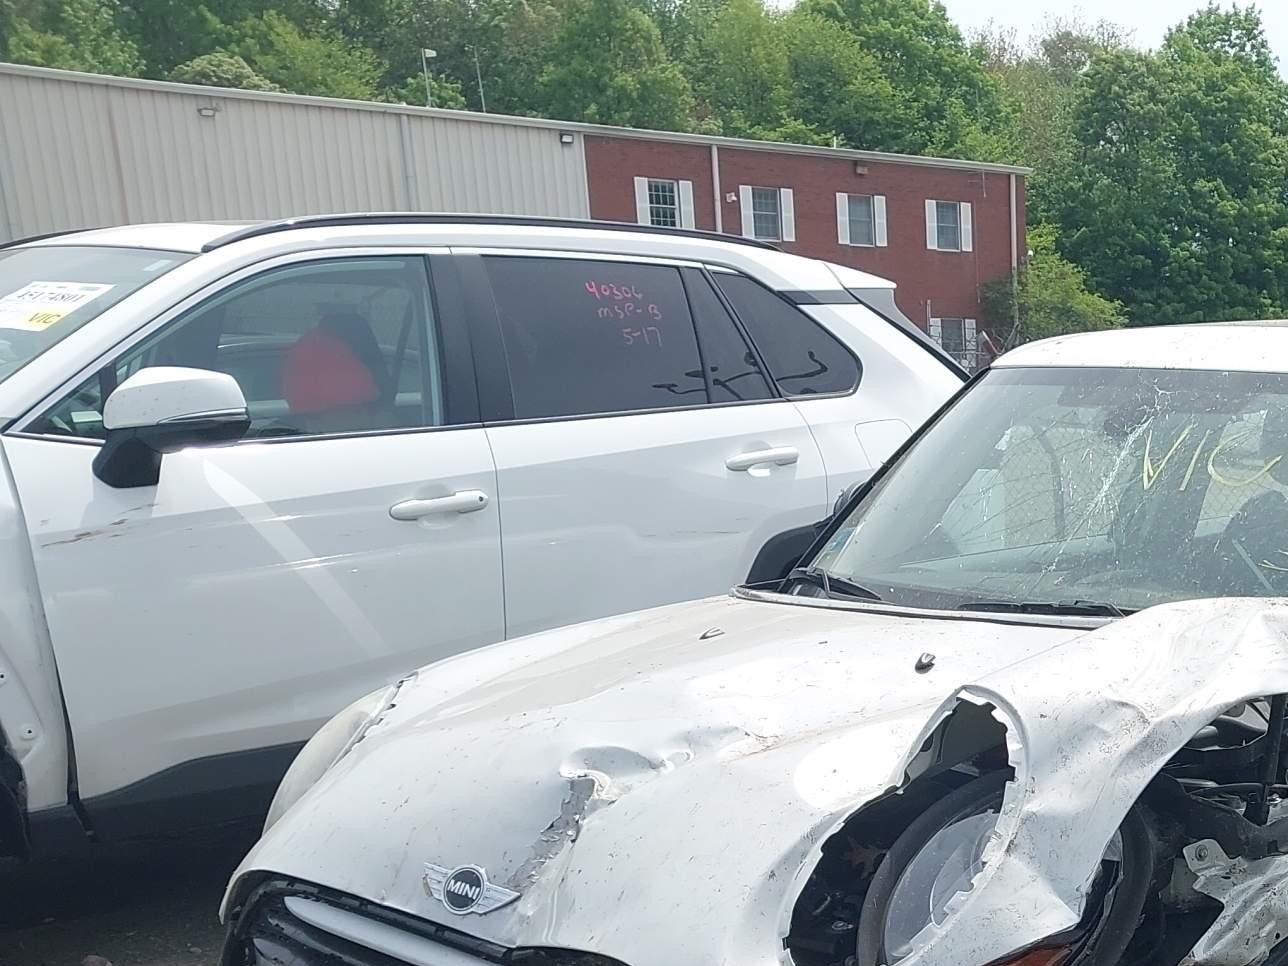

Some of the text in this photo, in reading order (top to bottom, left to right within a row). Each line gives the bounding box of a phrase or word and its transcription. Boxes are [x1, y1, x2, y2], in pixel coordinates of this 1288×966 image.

[28, 312, 61, 324] VIC
[1142, 422, 1282, 490] VIC
[447, 879, 480, 900] MINI
